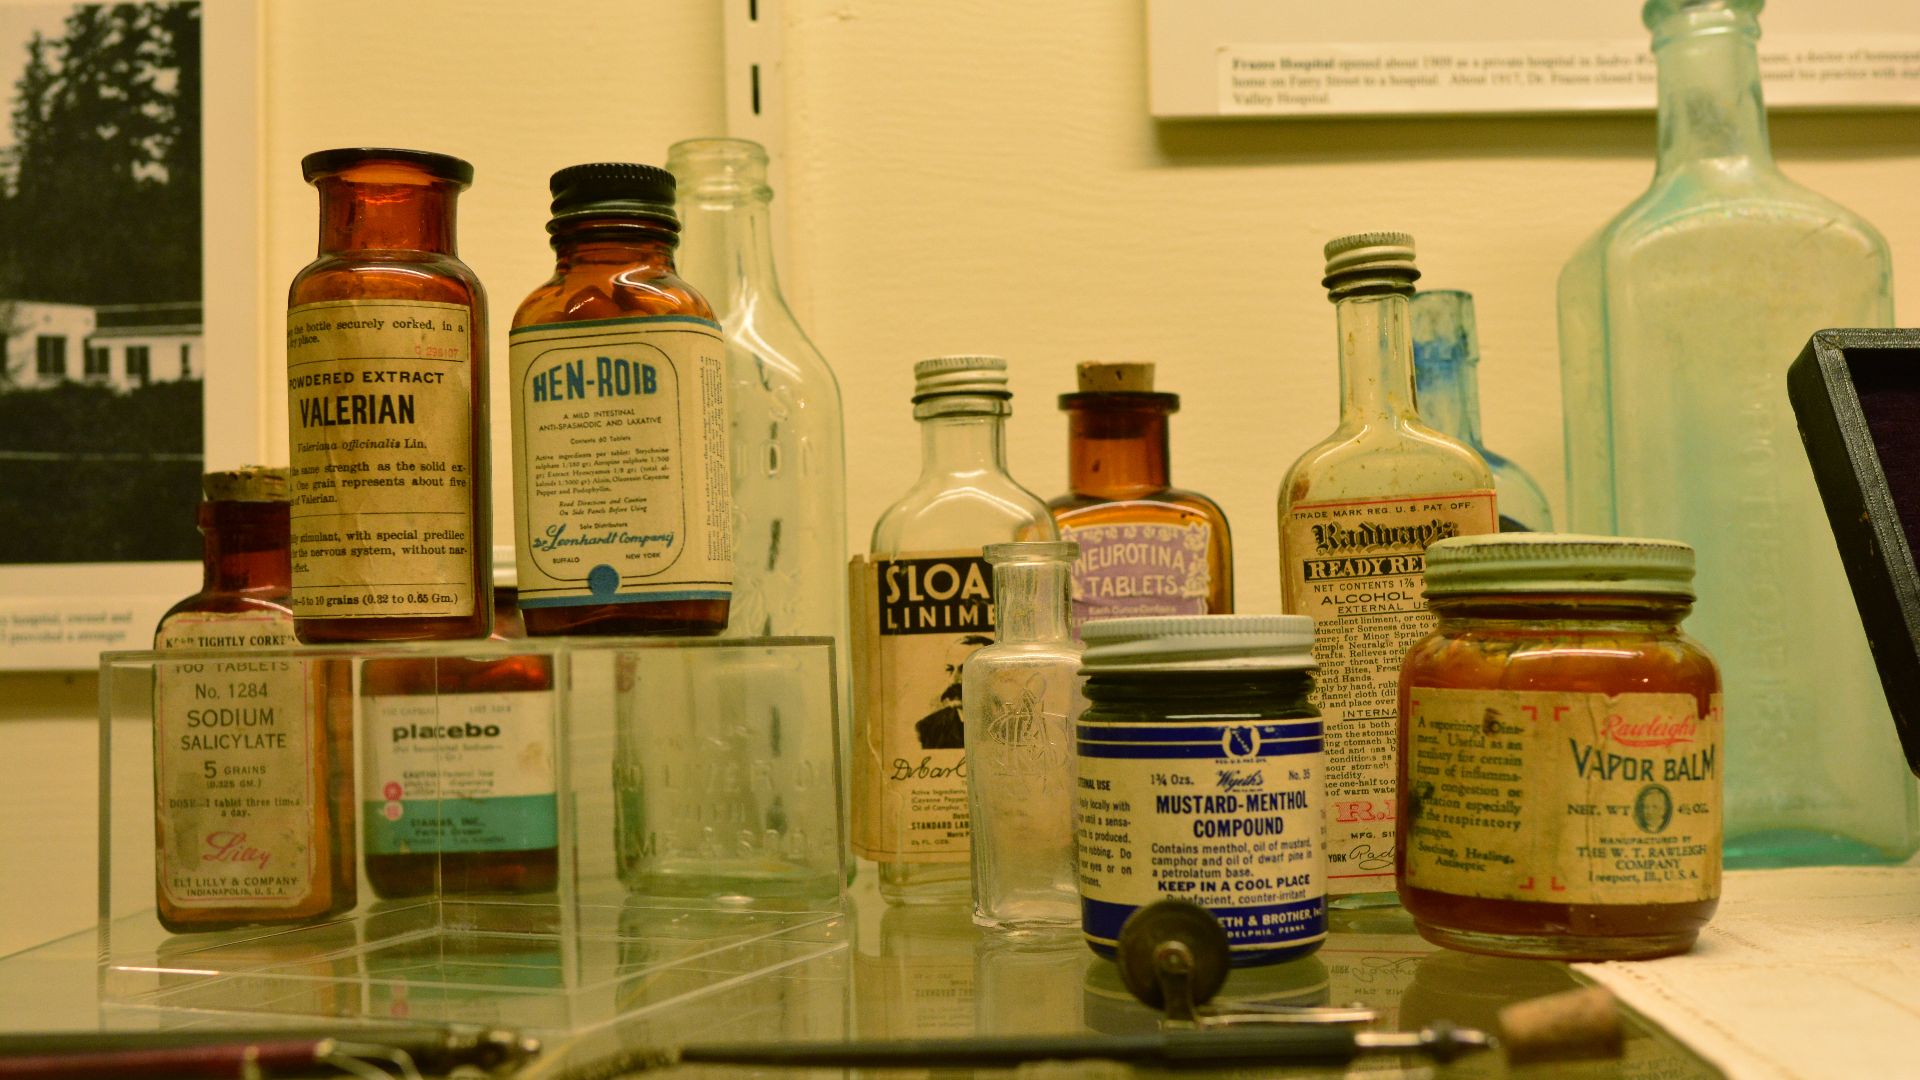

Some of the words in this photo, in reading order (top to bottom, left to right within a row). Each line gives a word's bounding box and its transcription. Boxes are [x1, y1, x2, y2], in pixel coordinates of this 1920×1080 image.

[336, 319, 384, 330] securely
[393, 320, 435, 331] corked,
[443, 321, 452, 330] in
[458, 324, 464, 332] a
[289, 372, 354, 390] POWDERED
[363, 372, 444, 384] EXTRACT
[533, 357, 657, 402] HEN-ROIB
[300, 395, 414, 428] VALERIAN
[539, 420, 601, 432] ANTI-SPASMODIC
[628, 417, 662, 425] LAXATIVE
[342, 440, 400, 450] officinalis
[405, 440, 427, 449] Lin.
[324, 462, 369, 474] strength
[397, 462, 415, 471] the
[420, 462, 445, 471] solid
[313, 479, 335, 490] grain
[342, 479, 404, 488] represents
[412, 478, 443, 486] about
[450, 478, 466, 487] five
[1294, 512, 1328, 520] TRADE
[1334, 509, 1362, 518] MARK
[1451, 502, 1474, 510] OFF.
[347, 532, 371, 540] with
[377, 532, 417, 541] special
[544, 523, 617, 552] Leonhardt
[619, 532, 674, 548] Company
[1312, 519, 1458, 556] Radway's
[351, 547, 395, 557] system,
[403, 546, 445, 555] without
[1074, 543, 1185, 575] NEUROTINA
[1308, 561, 1382, 580] READY
[1087, 575, 1178, 597] TABLETS
[1314, 585, 1333, 593] NET
[1339, 581, 1393, 591] CONTENTS
[327, 595, 359, 606] grains
[392, 596, 404, 604] to
[1322, 592, 1413, 605] ALCOHOL
[1338, 605, 1403, 614] EXTERNAL
[1319, 616, 1358, 626] excellent
[199, 636, 245, 647] TIGHTLY
[1349, 641, 1393, 649] Neuralgic
[195, 684, 220, 699] No.
[229, 682, 268, 698] 1284
[1322, 692, 1351, 700] flannel
[1349, 700, 1372, 708] place
[187, 708, 274, 728] SODIUM
[393, 722, 500, 742] placebo
[181, 734, 287, 751] SALICYLATE
[1344, 738, 1382, 746] stomach
[1458, 751, 1473, 762] for
[1480, 754, 1522, 766] certain
[1570, 738, 1653, 781] VAPOR
[1664, 744, 1714, 781] BALM
[204, 761, 217, 779] 5
[224, 766, 266, 774] GRAINS
[1445, 765, 1456, 776] of
[1171, 775, 1194, 785] Ozs.
[1340, 779, 1376, 788] one-half
[1441, 783, 1499, 796] congestion
[1113, 802, 1130, 811] with
[1156, 791, 1308, 815] MUSTARD-MENTHOL
[1466, 801, 1521, 815] especially
[231, 809, 251, 817] day.
[912, 822, 952, 830] STANDARD
[1105, 817, 1131, 827] sensa-
[1193, 817, 1283, 838] COMPOUND
[1443, 815, 1521, 831] respiratory
[1095, 832, 1131, 843] produced.
[202, 831, 272, 869] Lilly
[1120, 849, 1131, 859] Do
[1152, 842, 1198, 855] Contains
[1253, 841, 1265, 851] oil
[1269, 840, 1278, 850] of
[1577, 848, 1606, 858] THE
[1649, 845, 1707, 858] RAWLEIGH
[1152, 855, 1198, 867] camphor
[1208, 856, 1222, 866] and
[1226, 855, 1239, 865] oil
[1243, 854, 1252, 864] of
[1258, 853, 1284, 865] dwarf
[1288, 852, 1303, 862] pine
[1328, 853, 1346, 862] YORK
[1121, 866, 1132, 875] on
[1616, 859, 1680, 870] COMPANY
[1152, 869, 1158, 877] a
[1161, 866, 1221, 879] petrolatum
[1226, 866, 1254, 877] base.
[196, 878, 226, 887] LILLY
[245, 877, 297, 885] COMPANY
[1158, 880, 1196, 892] KEEP
[1200, 880, 1216, 891] IN
[1221, 880, 1231, 891] A
[1235, 877, 1272, 891] COOL
[1276, 874, 1310, 888] PLACE
[1238, 889, 1306, 904] counter-irritant
[1248, 916, 1258, 927] &
[1262, 909, 1313, 927] BROTHER,
